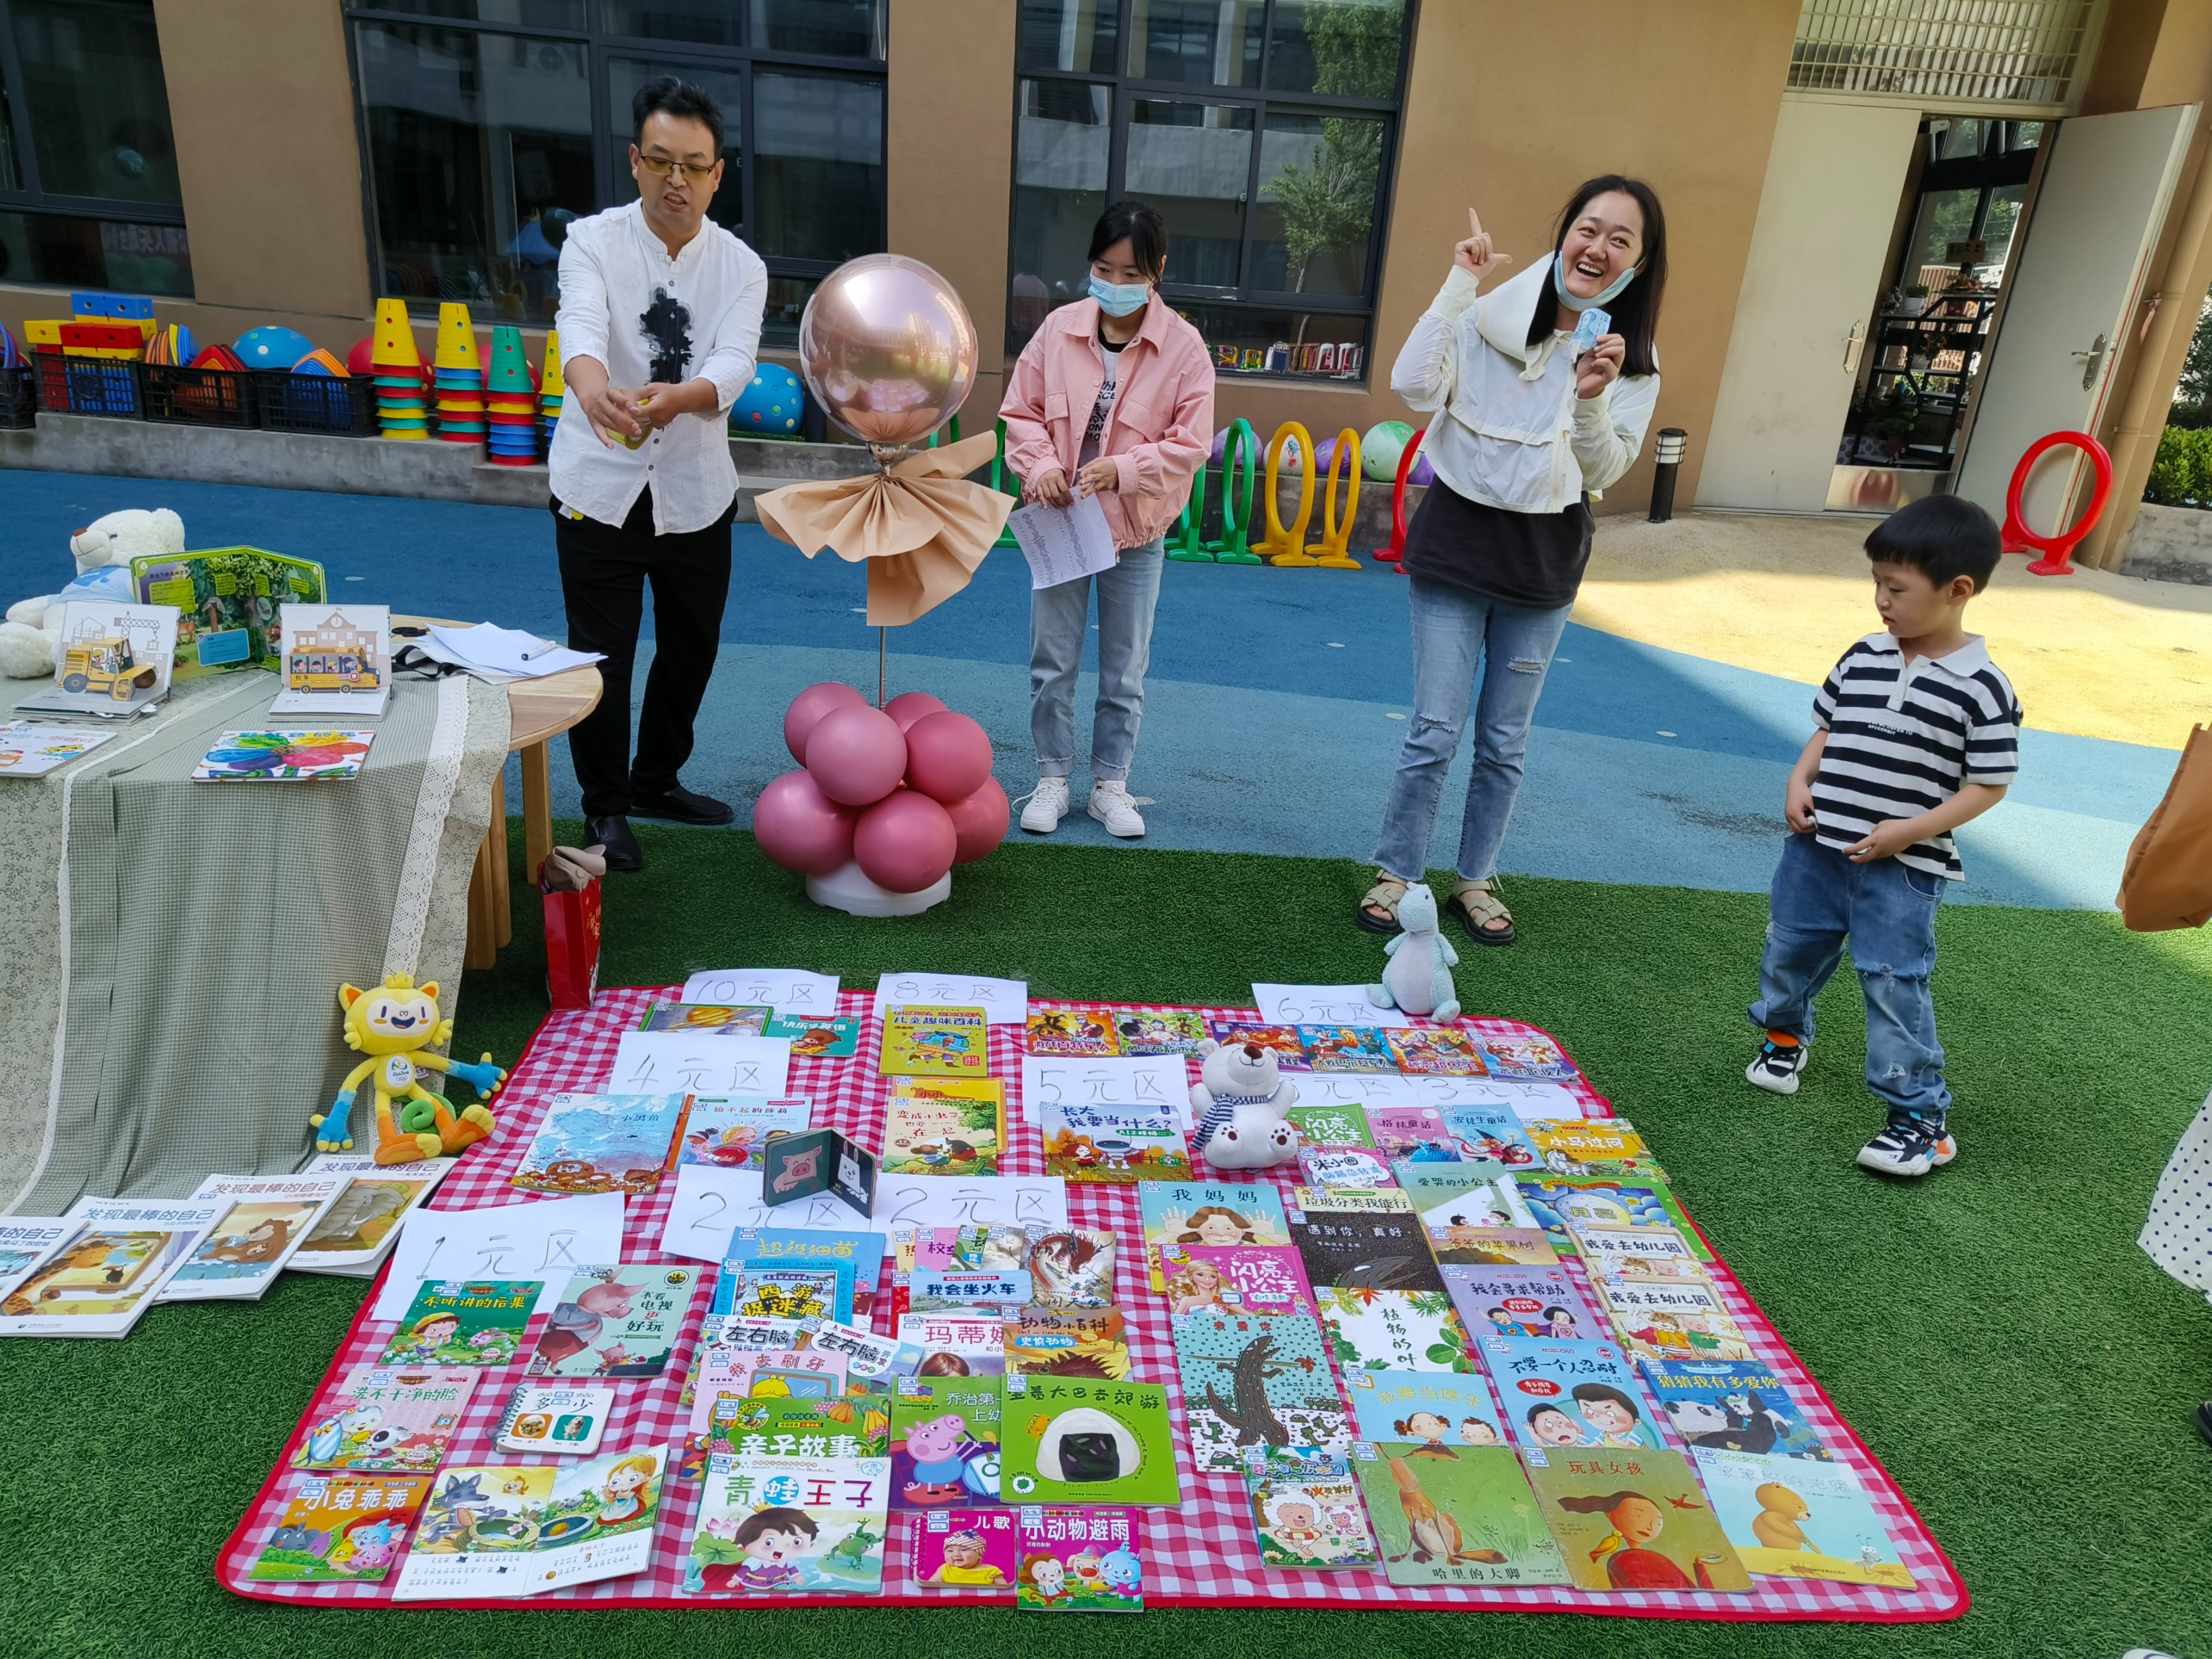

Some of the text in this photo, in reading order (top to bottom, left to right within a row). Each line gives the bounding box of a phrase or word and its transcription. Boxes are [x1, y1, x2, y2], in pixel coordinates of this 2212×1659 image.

[696, 980, 815, 1005] 10元区
[895, 982, 1001, 1002] 8元区
[1277, 998, 1376, 1022] 6元区
[893, 1016, 983, 1026] 儿童趣味百科
[628, 1054, 770, 1094] 4元区
[1041, 1069, 1167, 1102] 5元区
[1423, 1079, 1551, 1101] 3元区
[897, 1111, 958, 1119] 变成小虫子
[1061, 1106, 1094, 1116] 长大
[1304, 1116, 1348, 1131] 闪亮
[1377, 1119, 1431, 1129] 格林童话
[1452, 1116, 1507, 1125] 安徒生童话
[913, 1127, 956, 1137] 在一起
[1307, 1128, 1364, 1140] 小公主
[1549, 1135, 1625, 1150] 小马过河
[319, 1161, 441, 1172] 发现最棒的自己
[1313, 1157, 1358, 1171] 米小圈
[209, 1181, 337, 1194] 发现最棒的自己
[1418, 1177, 1499, 1187] 爱哭的小公主
[1171, 1189, 1257, 1203] 我妈妈
[1305, 1198, 1408, 1209] 垃圾分类我能行
[690, 1191, 842, 1231] 2元区
[891, 1187, 1052, 1225] 2元区
[80, 1208, 216, 1221] 发现最棒的自己
[756, 1238, 859, 1258] 超级细菌
[1449, 1238, 1535, 1250] 爷爷的苹果树
[1585, 1239, 1682, 1253] 我爱去幼儿园
[416, 1229, 580, 1280] 1元区
[1230, 1260, 1282, 1279] 闪亮
[757, 1283, 815, 1299] 西游
[926, 1283, 1016, 1296] 我会坐火车
[1231, 1276, 1300, 1293] 小公主
[1470, 1282, 1565, 1296] 我会寻求帮助
[424, 1296, 525, 1309] 不听讲的后果
[641, 1290, 666, 1300] 不看
[1609, 1287, 1712, 1308] 我爱去幼儿园
[641, 1300, 673, 1311] 电视
[742, 1298, 826, 1317] 捉迷藏
[642, 1311, 661, 1321] 更
[625, 1321, 664, 1332] 好玩
[1021, 1316, 1110, 1334] 动物小百科
[725, 1325, 792, 1345] 左右脑
[1021, 1337, 1074, 1347] 史前动物
[1380, 1308, 1417, 1364] 植物的叶
[817, 1331, 880, 1363] 左右脑
[1507, 1356, 1617, 1374] 不要一个人忍耐
[1657, 1375, 1780, 1390] 猜猜我有多爱你
[351, 1386, 460, 1402] 洗不干净的脸
[1007, 1385, 1160, 1409] 坐着大巴去郊游
[529, 1397, 593, 1413] 多 少
[739, 1433, 857, 1458] 亲子故事
[1567, 1461, 1645, 1476] 玩具女孩
[1716, 1465, 1849, 1492] 笨笨熊的池塘
[724, 1474, 873, 1508] 青蛙王子
[304, 1486, 409, 1512] 小兔乖乖
[974, 1515, 1010, 1529] 儿歌
[1025, 1518, 1129, 1542] 小动物避雨
[1432, 1567, 1521, 1580] 哈里的大脚
